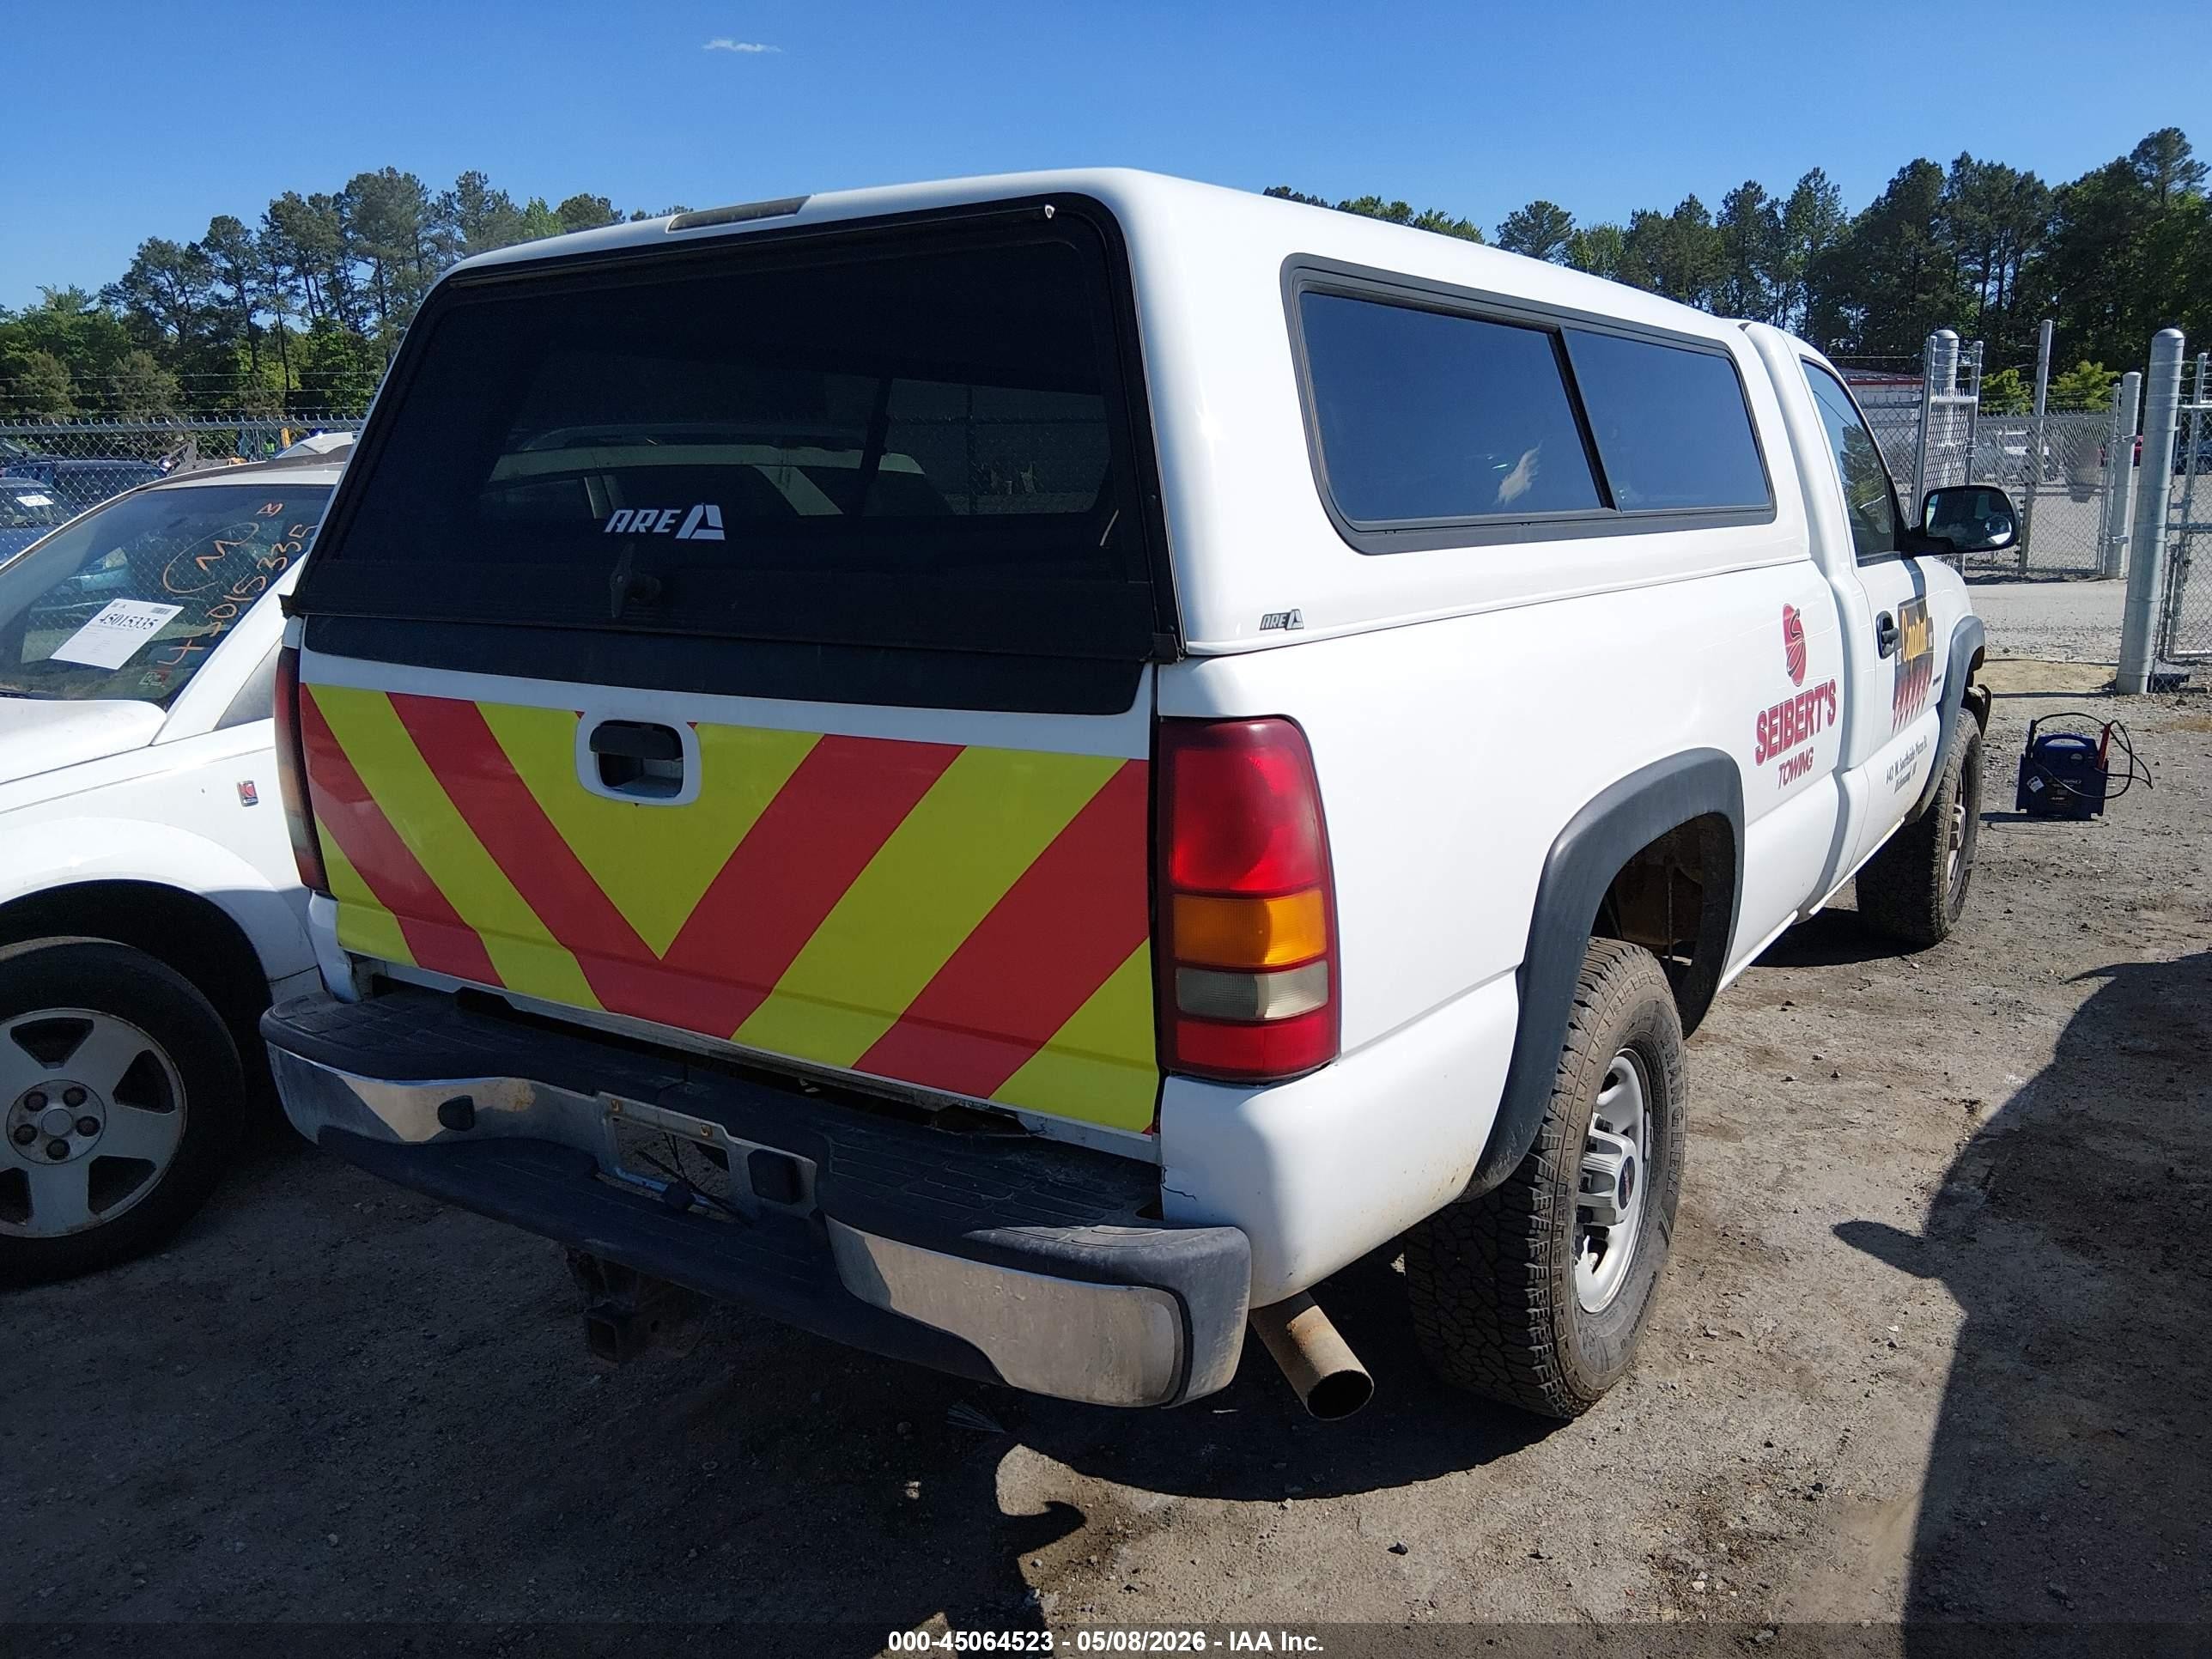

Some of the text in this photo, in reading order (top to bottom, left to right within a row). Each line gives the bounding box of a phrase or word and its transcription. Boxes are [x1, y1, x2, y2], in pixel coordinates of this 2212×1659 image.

[100, 612, 158, 630] 45015335
[1755, 678, 1837, 767] SEIBERT'S
[1778, 746, 1814, 791] TOWING
